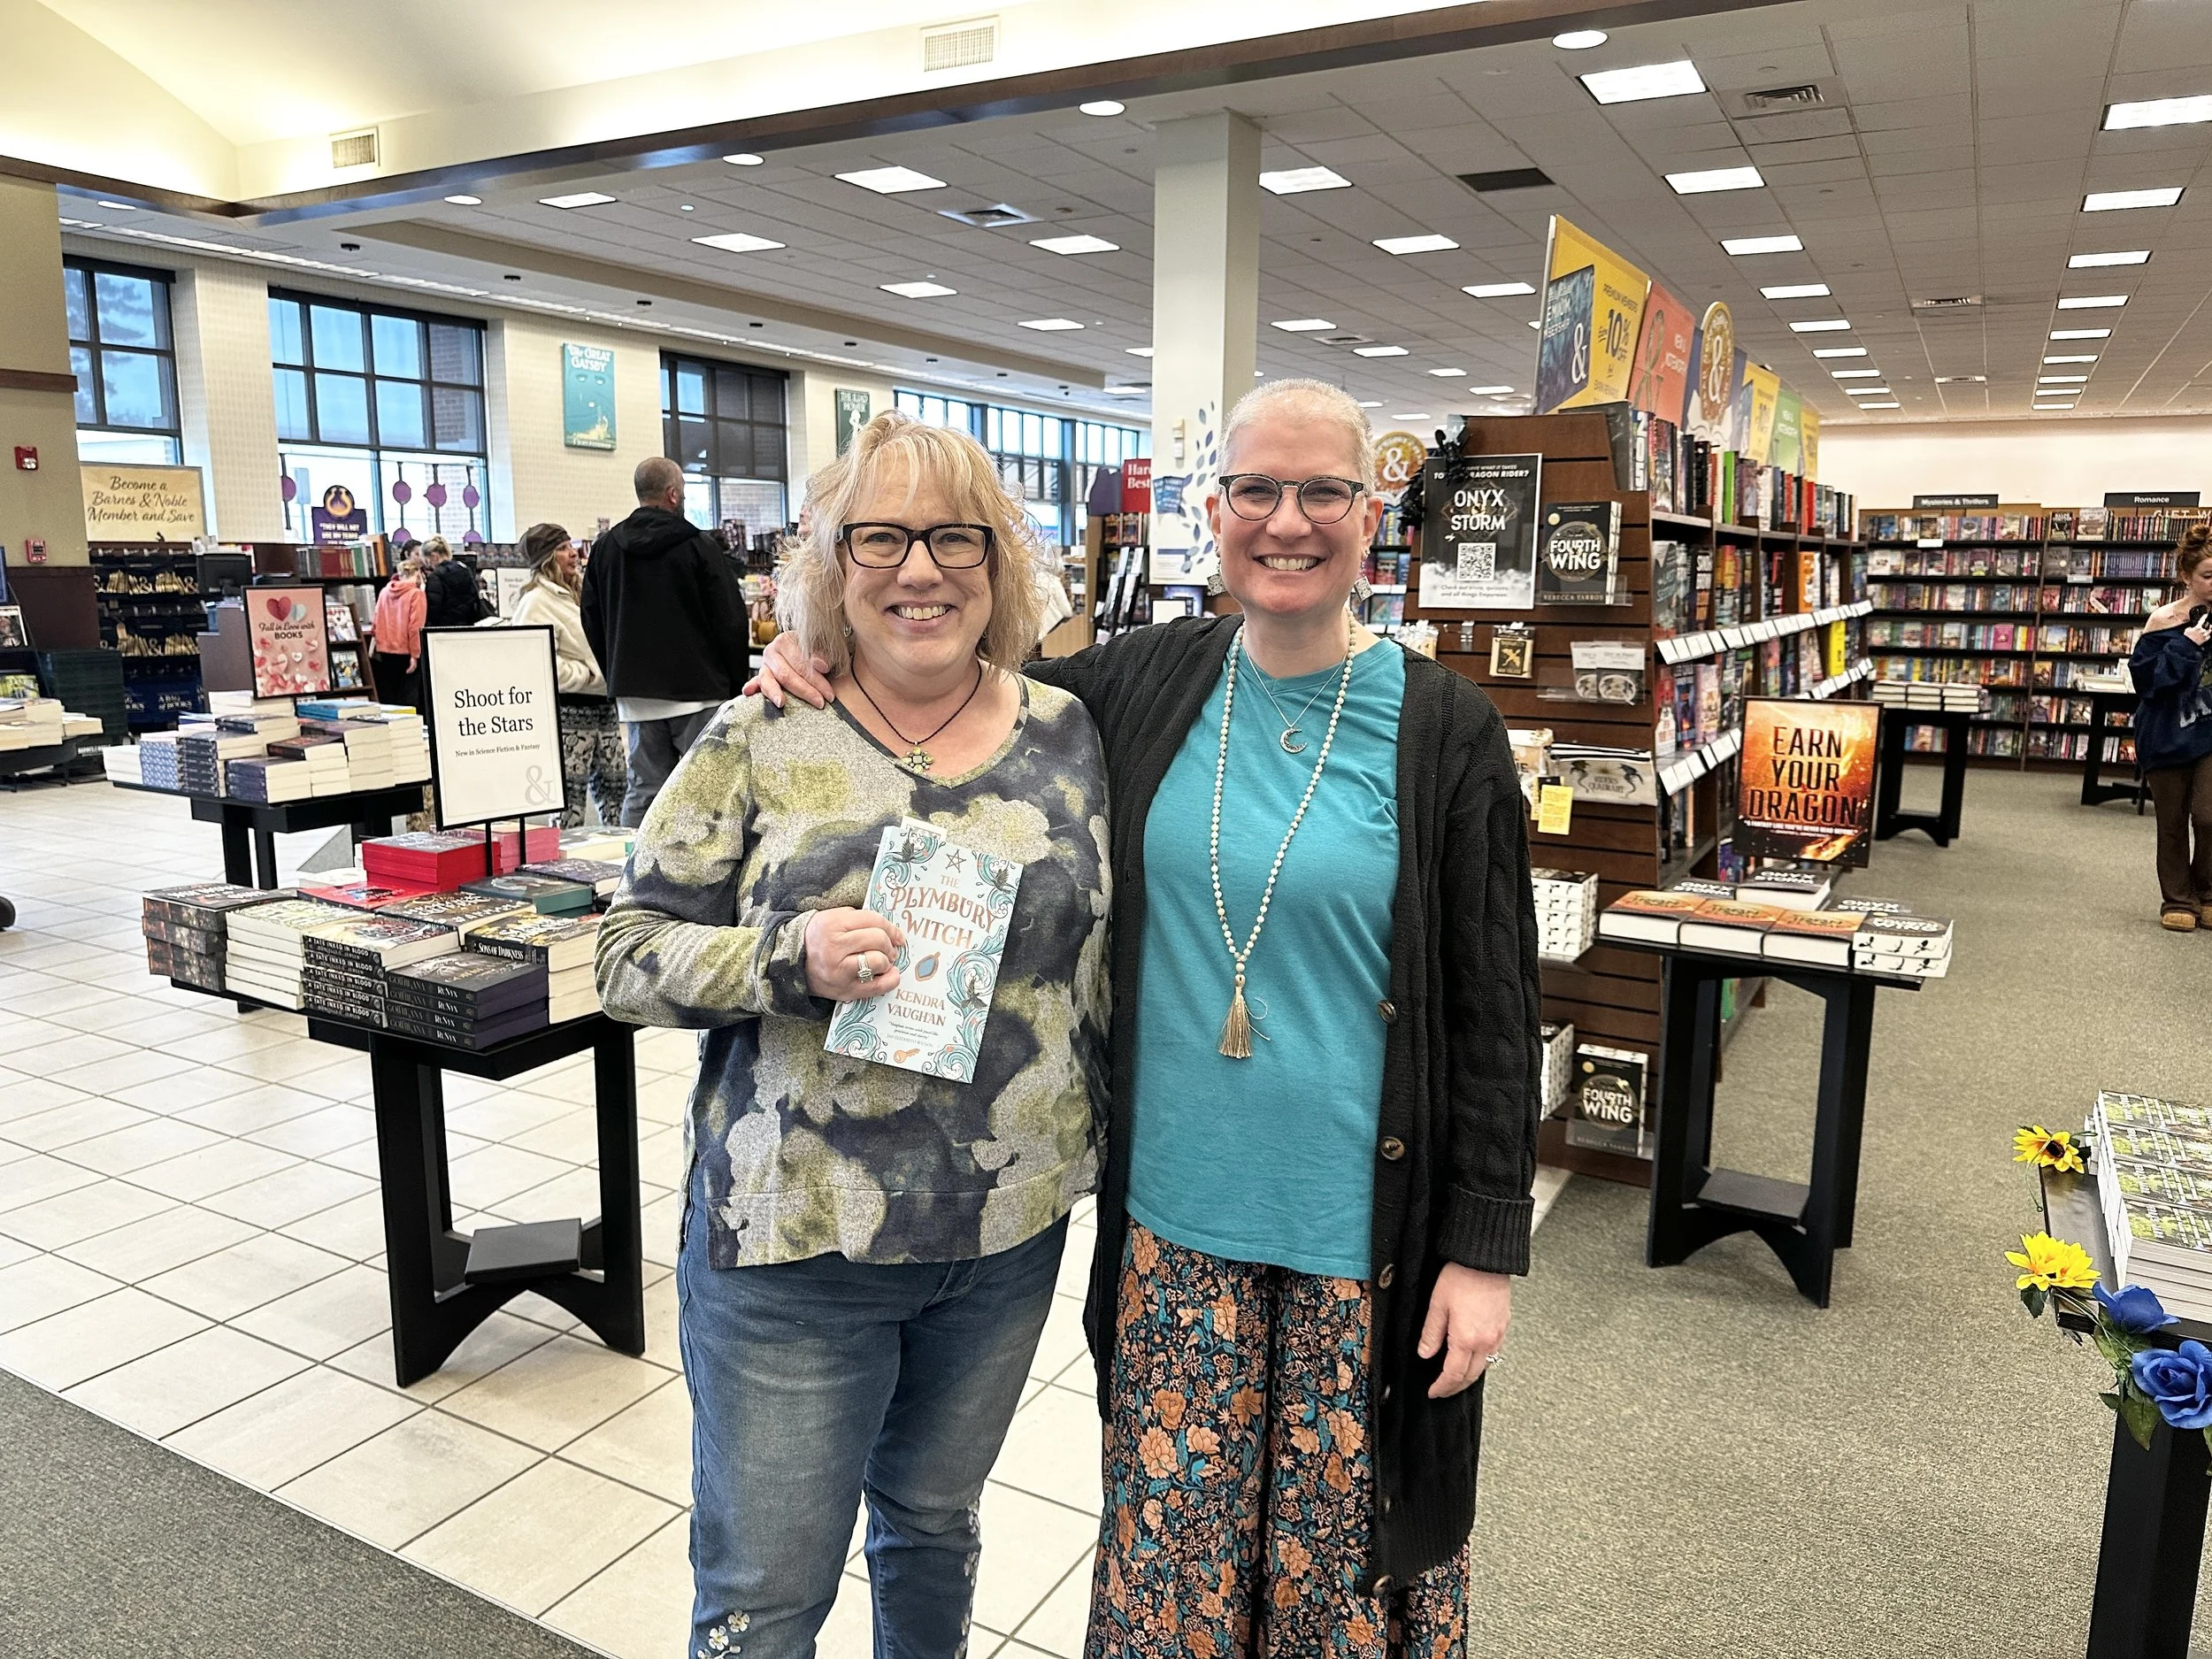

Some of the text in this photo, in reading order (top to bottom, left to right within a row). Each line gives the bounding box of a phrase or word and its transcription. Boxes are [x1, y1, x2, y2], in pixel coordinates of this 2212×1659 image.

[1606, 309, 1622, 357] 10
[1571, 322, 1587, 384] &
[571, 356, 608, 373] GATSBY
[1709, 334, 1725, 404] &
[1382, 447, 1410, 482] &
[110, 476, 168, 491] Become a
[92, 490, 188, 509] Barnes & Noble
[1454, 489, 1505, 507] ONYX
[88, 507, 195, 525] Member and Save
[1451, 514, 1506, 531] STORM
[1550, 539, 1601, 553] FOURTH
[1549, 552, 1601, 571] WING
[454, 686, 533, 709] Shoot for
[458, 716, 534, 736] the Stars
[496, 745, 515, 754] Fiction
[521, 743, 541, 752] Fantasy
[1772, 726, 1842, 758] EARN
[1770, 758, 1840, 792] YOUR
[525, 764, 557, 806] &
[1748, 789, 1858, 826] DRAGON
[940, 874, 960, 888] THE
[1755, 871, 1816, 879] ONYX
[1755, 875, 1814, 885] STORM
[890, 886, 997, 933] PLYMBURY
[1842, 899, 1900, 910] ONYX
[901, 910, 973, 949] WITCH
[326, 941, 343, 950] INKED
[352, 948, 369, 956] BLOOD
[479, 943, 524, 961] SONS OF DARKNESS
[329, 956, 346, 965] INKED
[355, 963, 373, 972] BLOOD
[328, 973, 345, 982] INKED
[355, 979, 373, 988] BLOOD
[326, 987, 343, 995] INKED
[352, 993, 370, 1002] BLOOD
[895, 988, 946, 1010] KENDRA
[326, 1001, 343, 1010] INKED
[352, 1008, 370, 1017] BLOOD
[887, 1002, 947, 1027] VAUGHAN
[1583, 1087, 1632, 1107] FOURTH
[1582, 1099, 1632, 1124] WING
